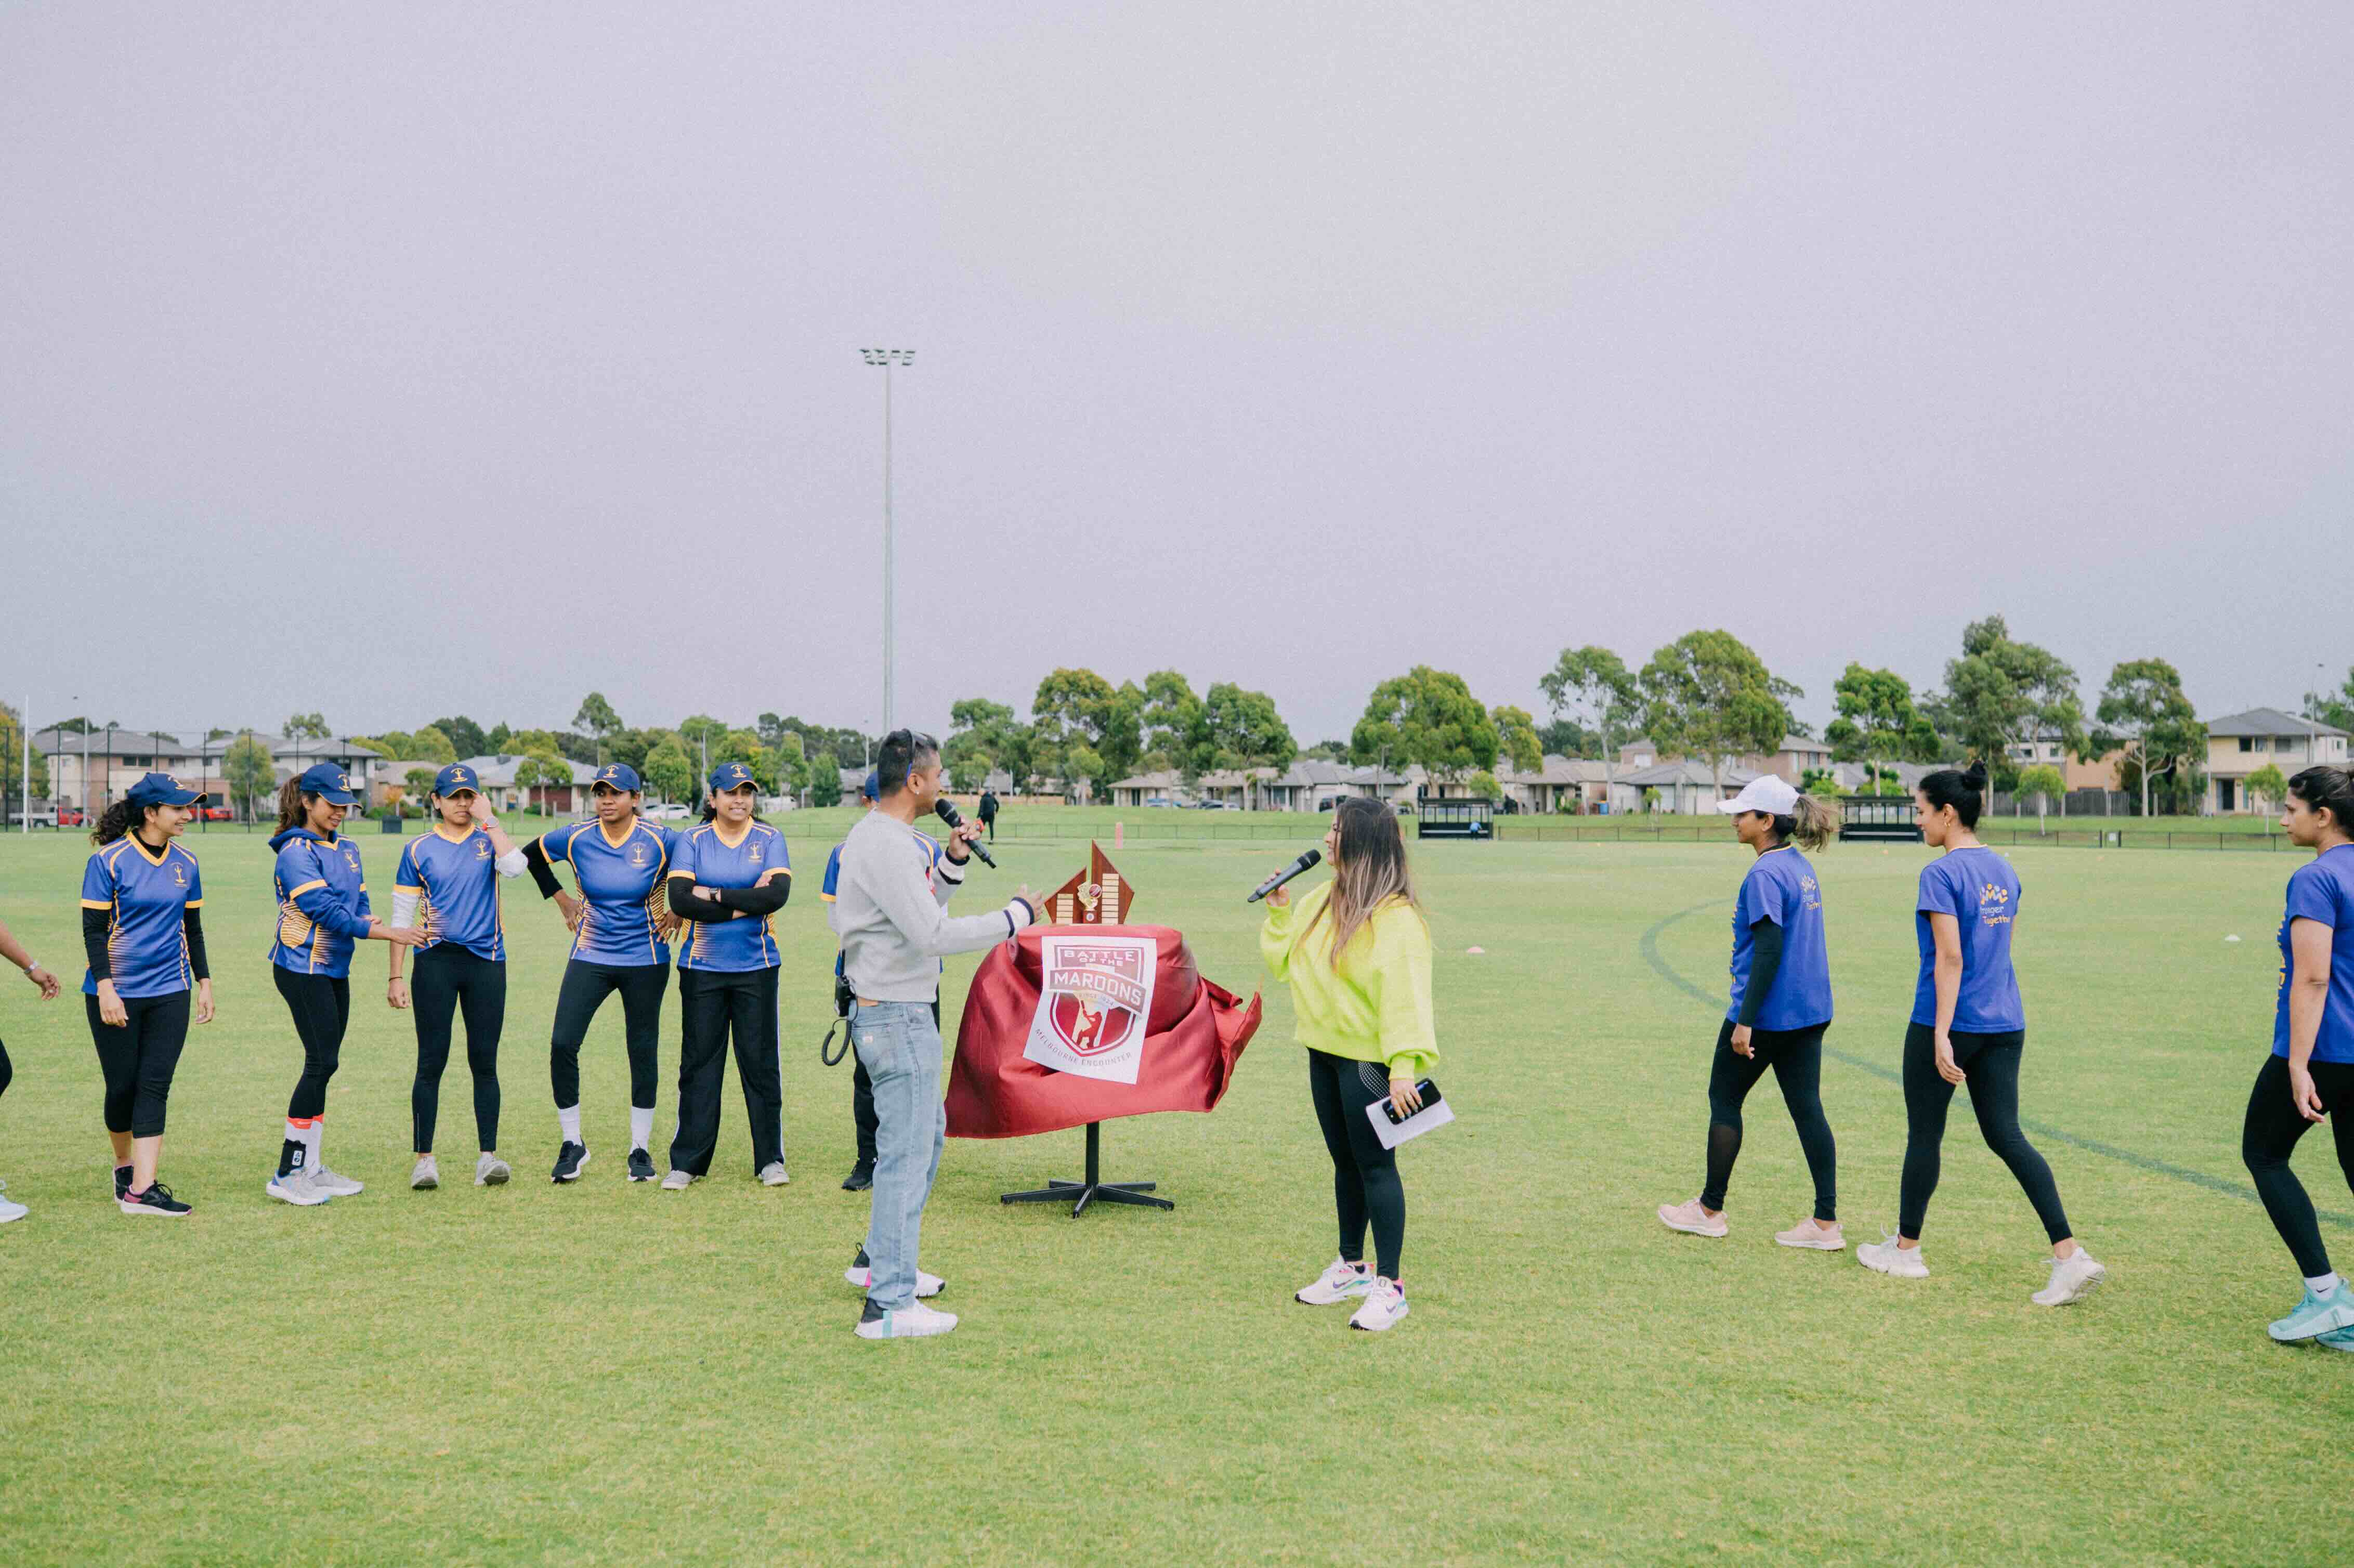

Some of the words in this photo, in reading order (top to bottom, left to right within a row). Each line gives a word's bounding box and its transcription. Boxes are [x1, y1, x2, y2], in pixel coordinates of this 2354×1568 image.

[1064, 950, 1136, 962] BATTLE
[1054, 972, 1142, 1006] MAROONS
[1035, 1028, 1078, 1063] MELBOURNE
[1081, 1051, 1132, 1066] ENCOUNTER
